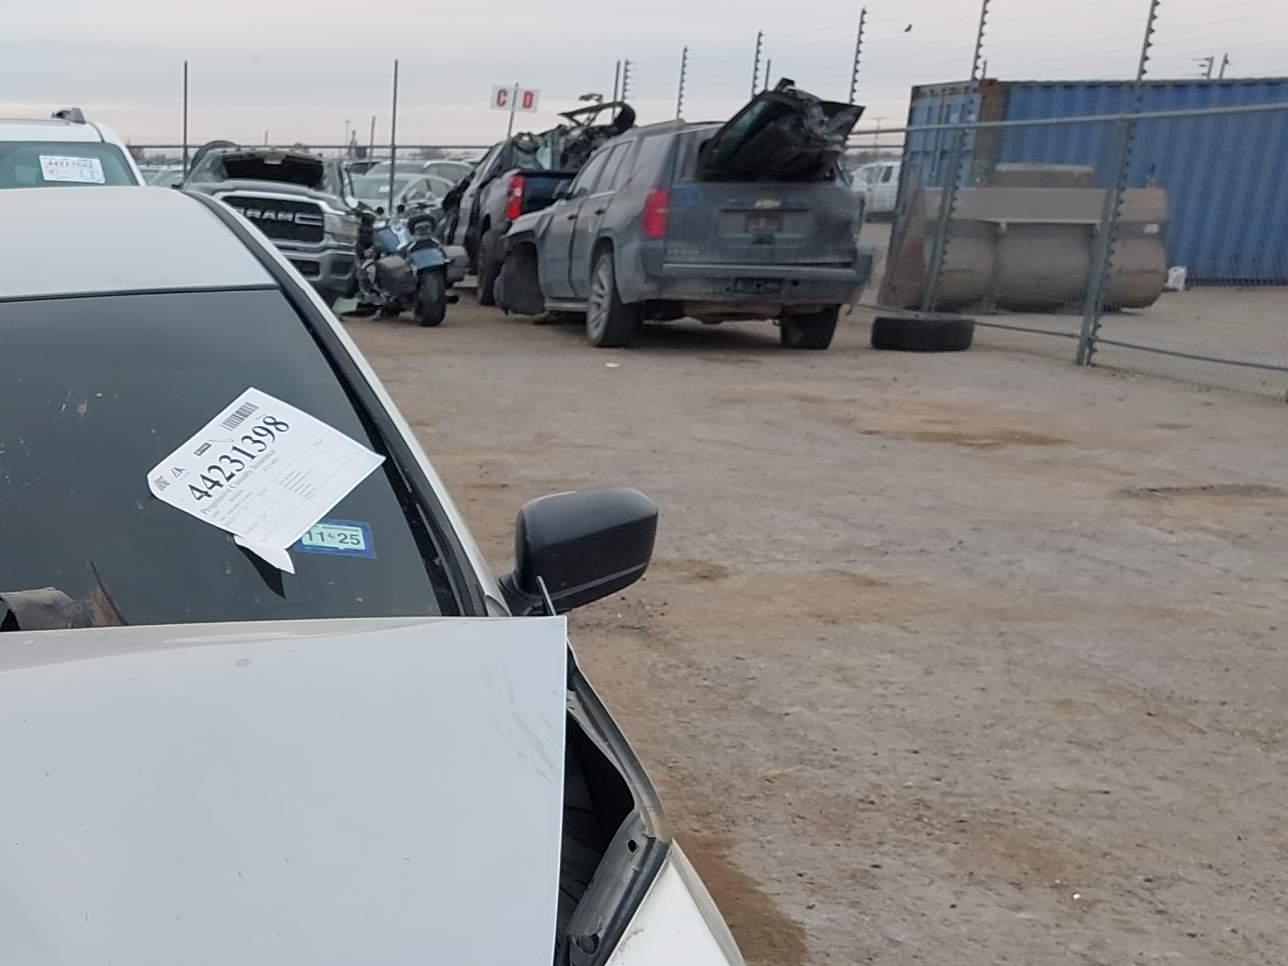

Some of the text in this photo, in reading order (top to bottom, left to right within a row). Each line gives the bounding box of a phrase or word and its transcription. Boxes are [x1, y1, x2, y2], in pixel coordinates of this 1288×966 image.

[496, 89, 508, 107] C
[246, 208, 294, 222] RAM
[187, 415, 290, 503] 44231398
[337, 532, 361, 546] 25
